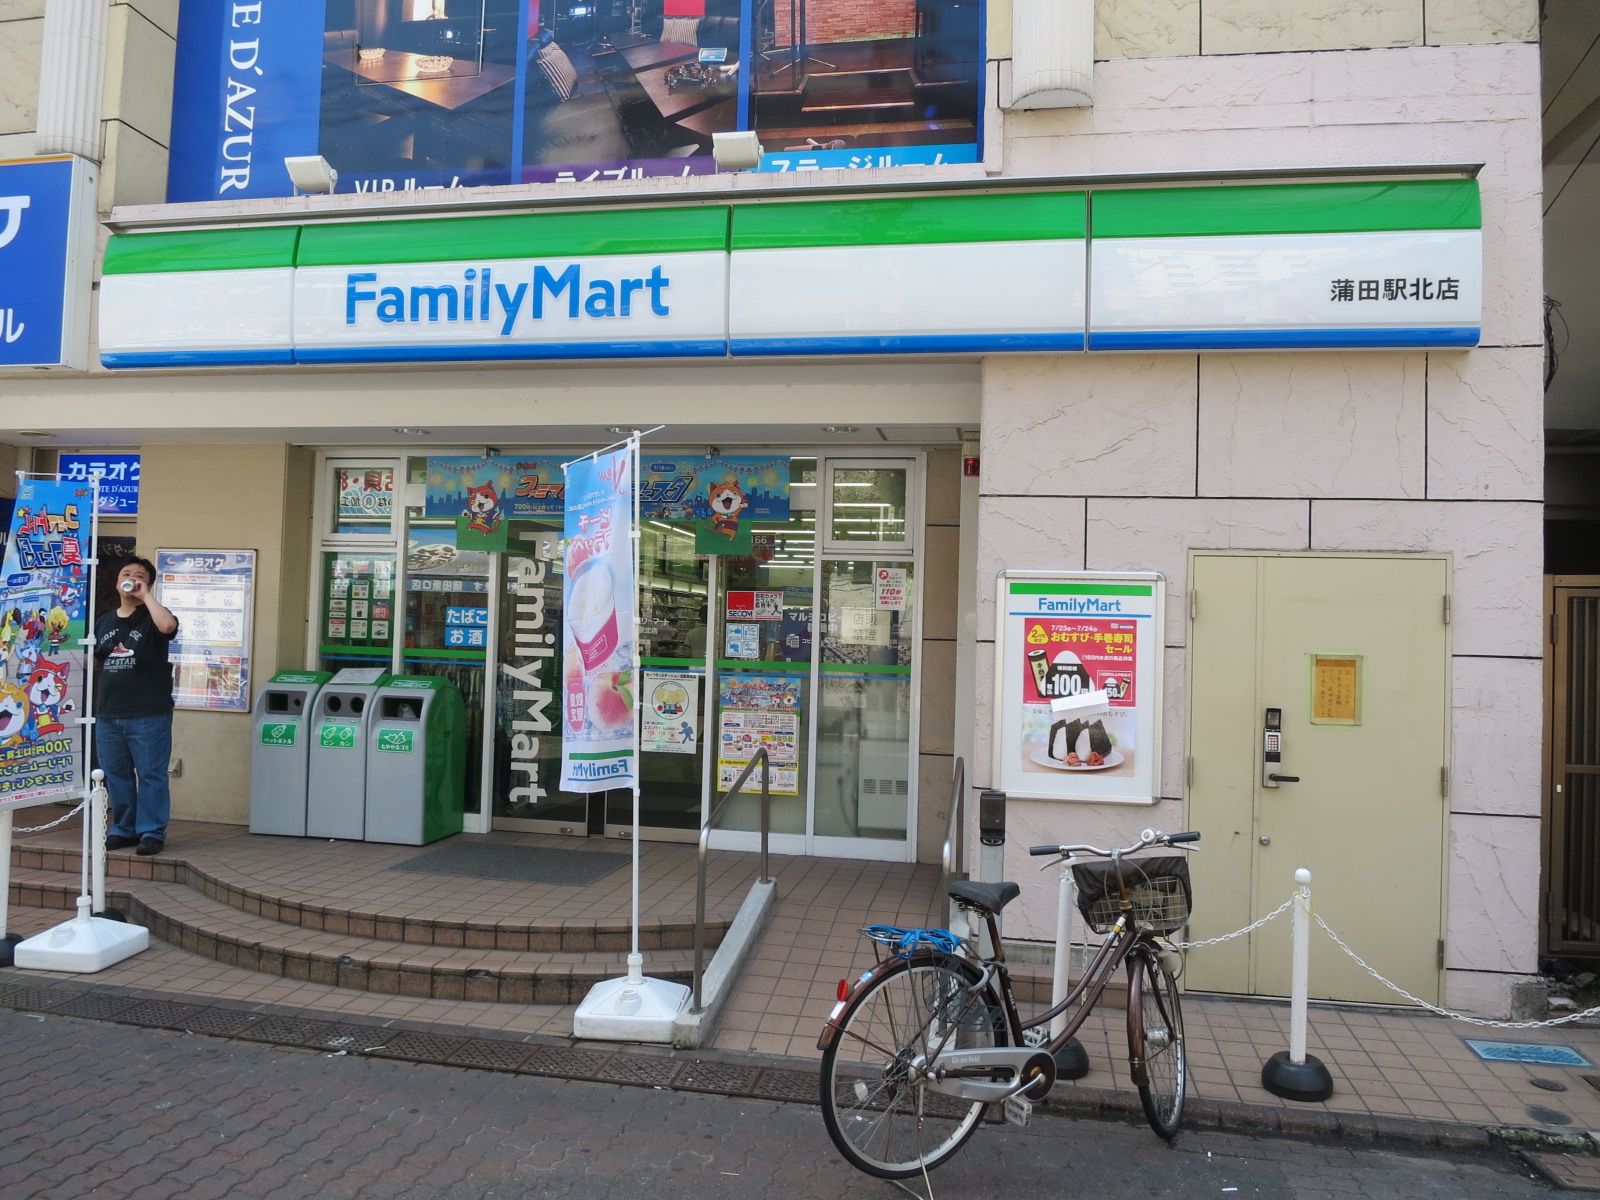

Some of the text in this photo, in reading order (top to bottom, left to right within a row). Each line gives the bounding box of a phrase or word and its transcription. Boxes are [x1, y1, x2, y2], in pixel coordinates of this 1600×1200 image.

[219, 40, 263, 194] D'AZUR
[1330, 277, 1460, 302] 蒲田駅北店
[346, 262, 670, 337] FamilyMart
[184, 556, 225, 568] カラオケ
[1038, 597, 1121, 614] FamilyMart
[447, 608, 488, 624] たばこ
[450, 629, 483, 645] お酒
[1051, 632, 1134, 644] おむすび・手巻寿司
[1105, 645, 1133, 654] セール
[503, 531, 556, 804] FamilyMart
